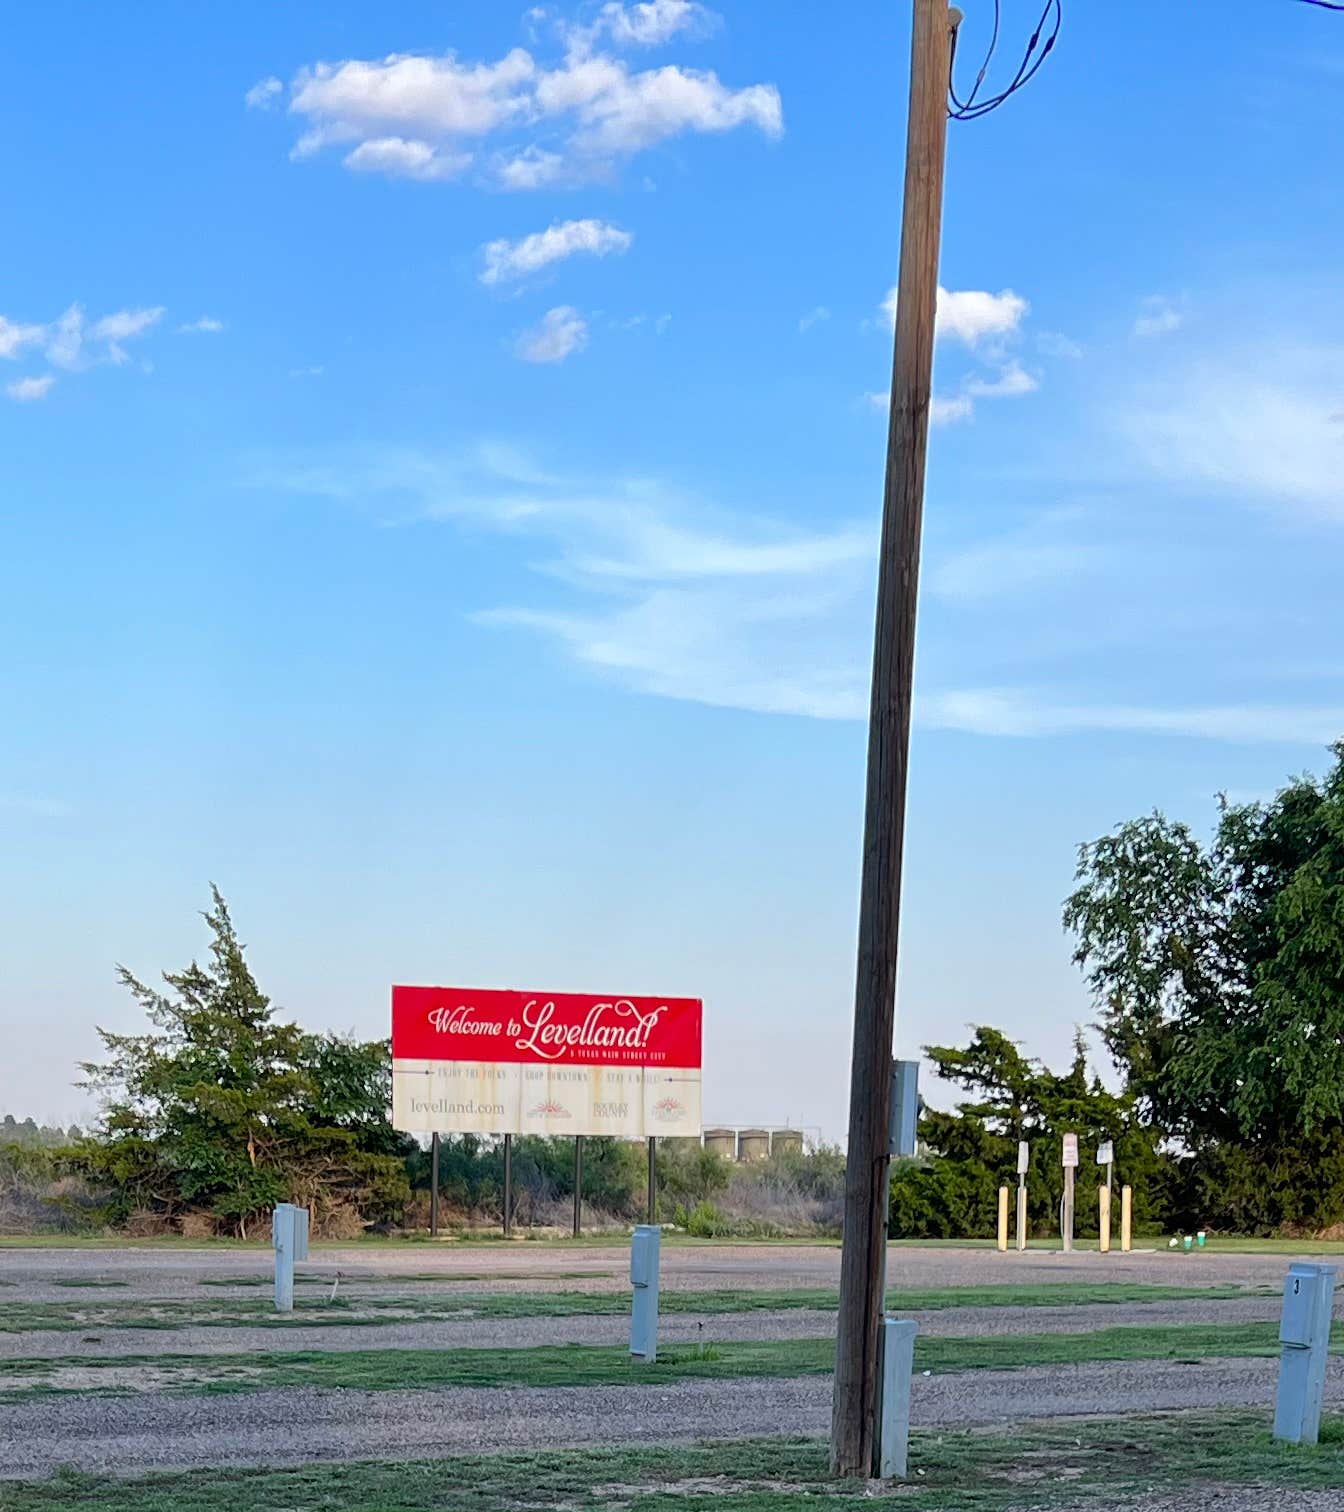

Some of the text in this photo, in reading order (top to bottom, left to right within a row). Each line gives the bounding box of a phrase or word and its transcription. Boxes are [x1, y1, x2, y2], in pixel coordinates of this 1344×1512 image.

[428, 999, 669, 1060] Welcome to Levelland!
[411, 1097, 505, 1115] levelland.com
